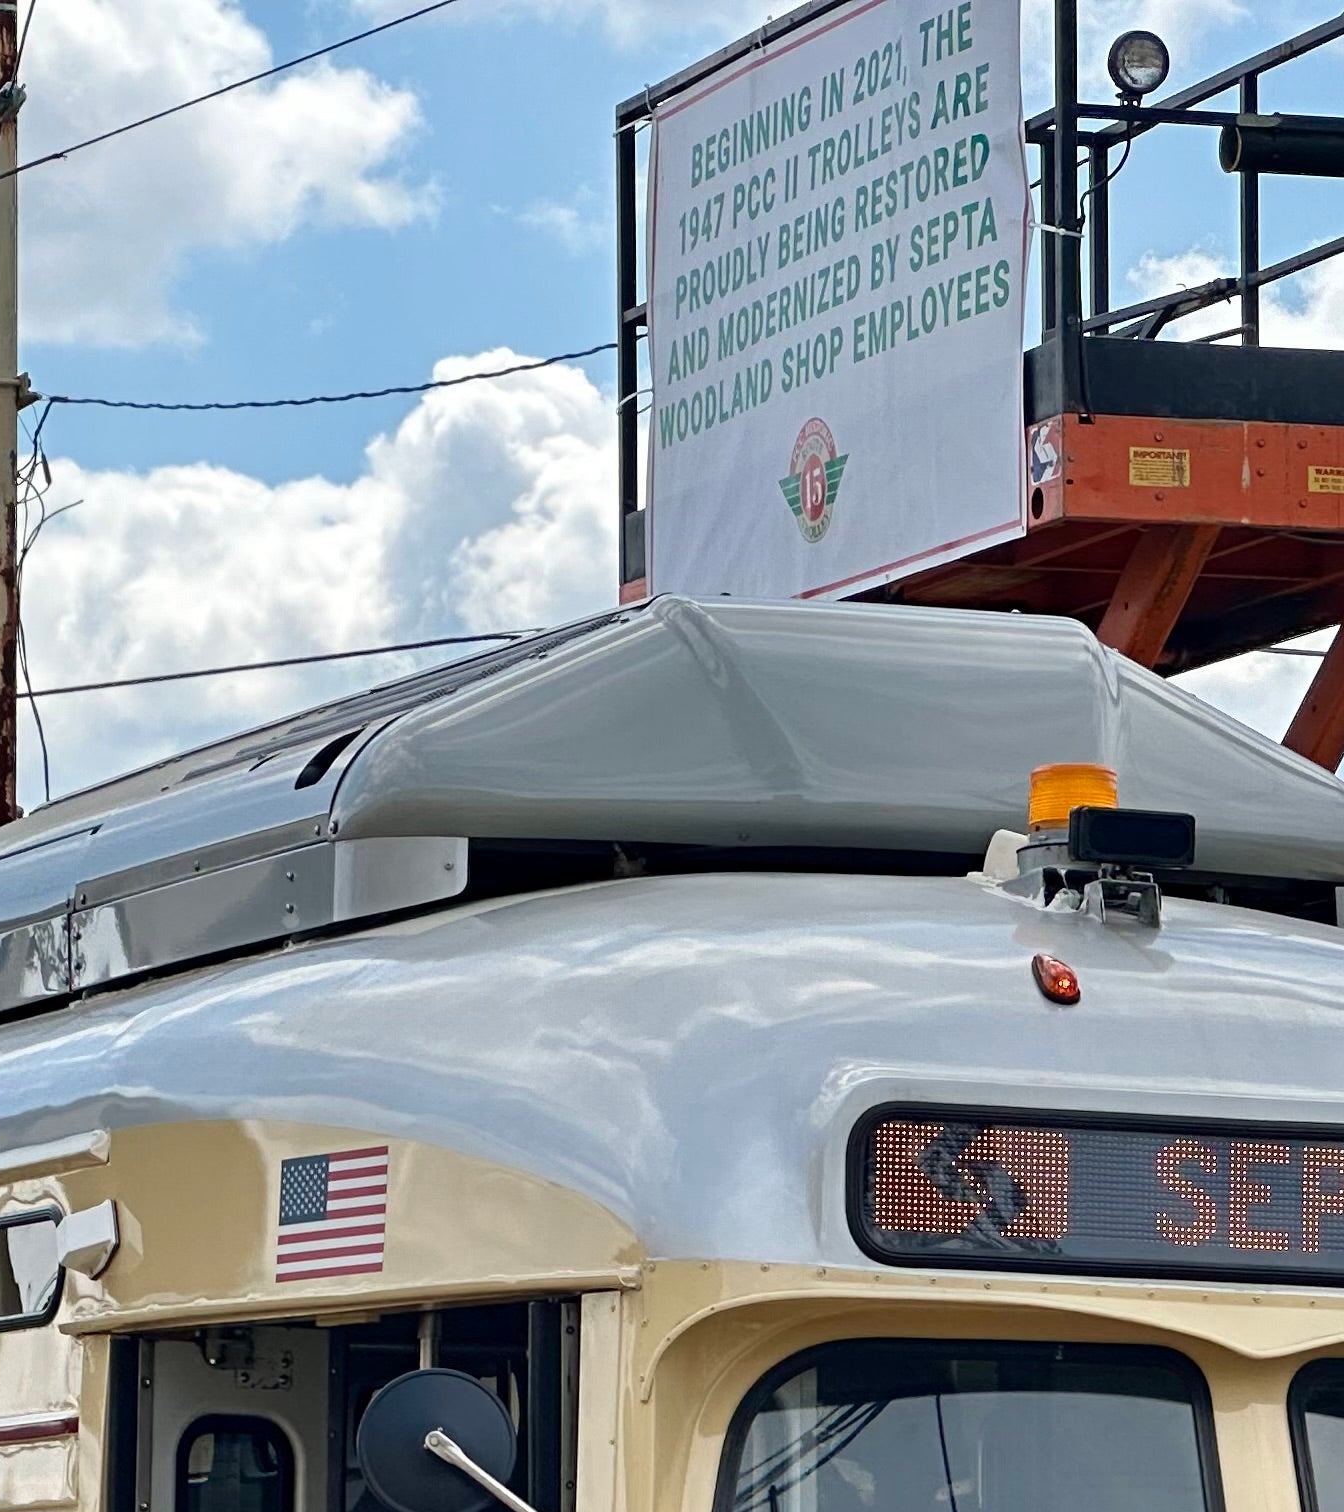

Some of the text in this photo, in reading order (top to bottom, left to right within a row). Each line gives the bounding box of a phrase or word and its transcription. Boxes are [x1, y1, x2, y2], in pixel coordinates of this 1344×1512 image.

[679, 62, 990, 256] 1947 PCC II TROLLEYS ARE
[691, 1, 973, 188] BEGINNING IN 2021, THE
[667, 197, 998, 385] AND MODERNIZED BY SEPTA
[675, 133, 991, 319] PROUDLY BEING RESTORED
[659, 259, 1010, 450] WOODLAND SHOP EMPLOYEES
[806, 467, 823, 509] 15
